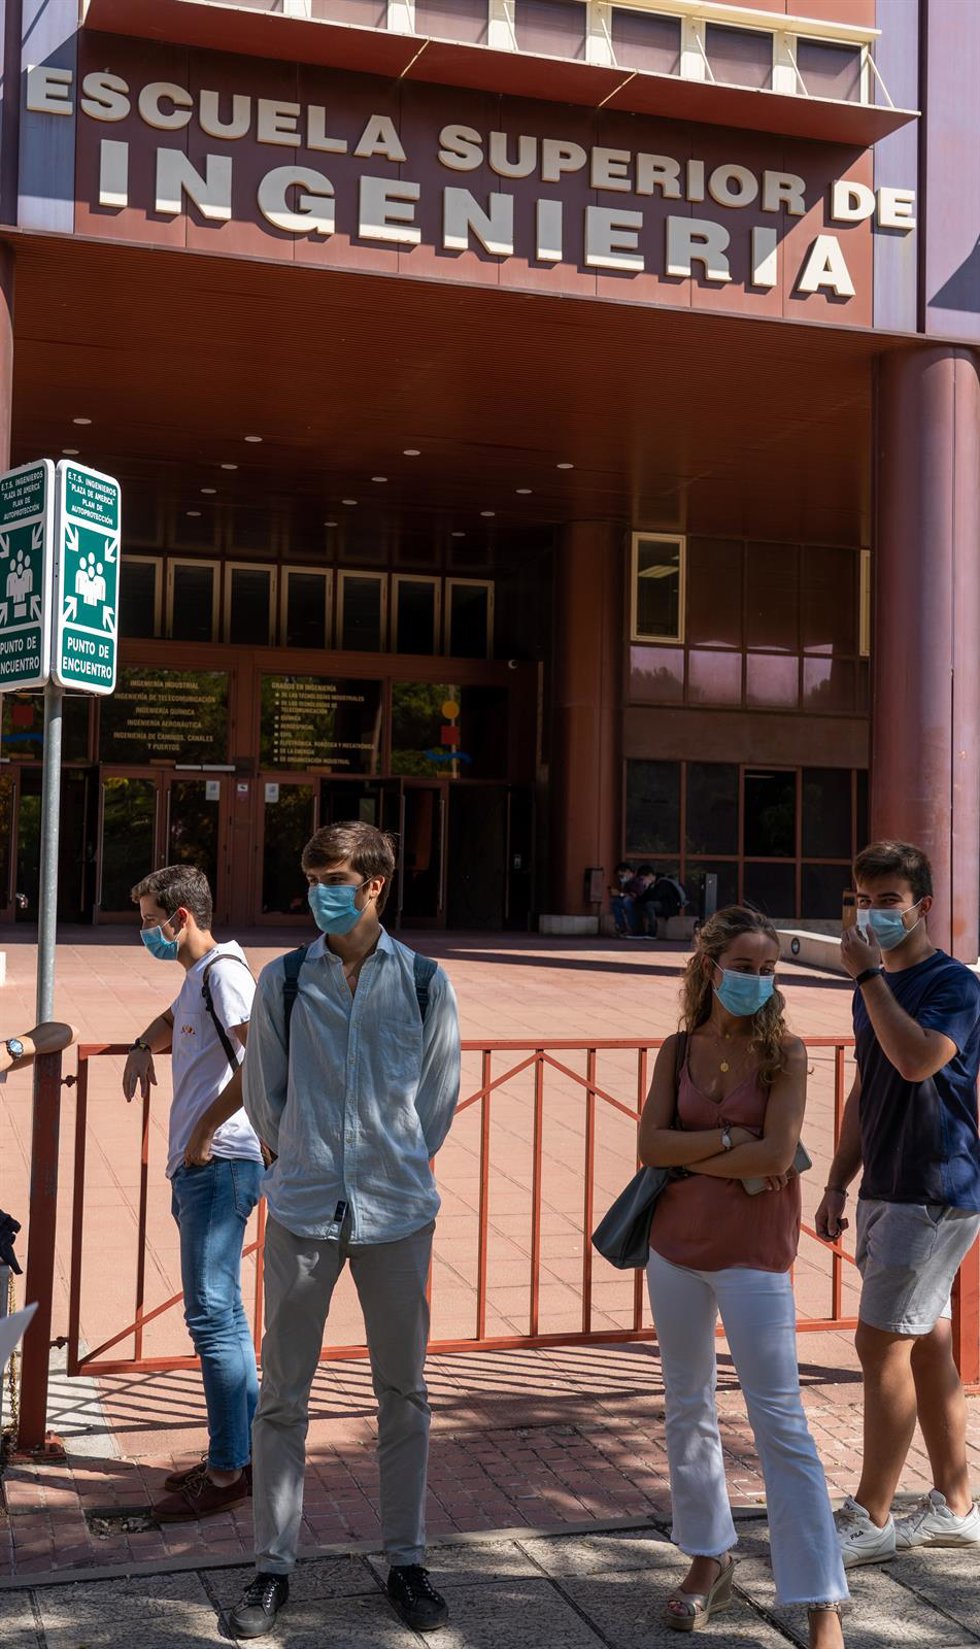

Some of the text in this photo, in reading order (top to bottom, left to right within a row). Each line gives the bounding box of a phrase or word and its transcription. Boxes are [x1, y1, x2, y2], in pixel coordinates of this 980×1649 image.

[26, 64, 917, 230] ESCUELA SUPERIOR DE
[98, 138, 856, 298] INGENIERIA
[1, 470, 43, 491] E.T.S. INGENIEROS
[67, 471, 116, 497] E.T.S. INGENIEROS
[12, 496, 31, 508] PLAN DE
[17, 487, 23, 497] DE
[87, 489, 93, 499] DE
[82, 498, 103, 512] PLAN DE
[71, 505, 113, 526] AUTOPROTECCIÓN
[0, 635, 37, 655] PUNTO DE
[67, 636, 109, 659] PUNTO DE
[0, 656, 39, 675] NCUENTRO
[62, 656, 112, 679] ENCUENTRO
[850, 1530, 864, 1541] FILA
